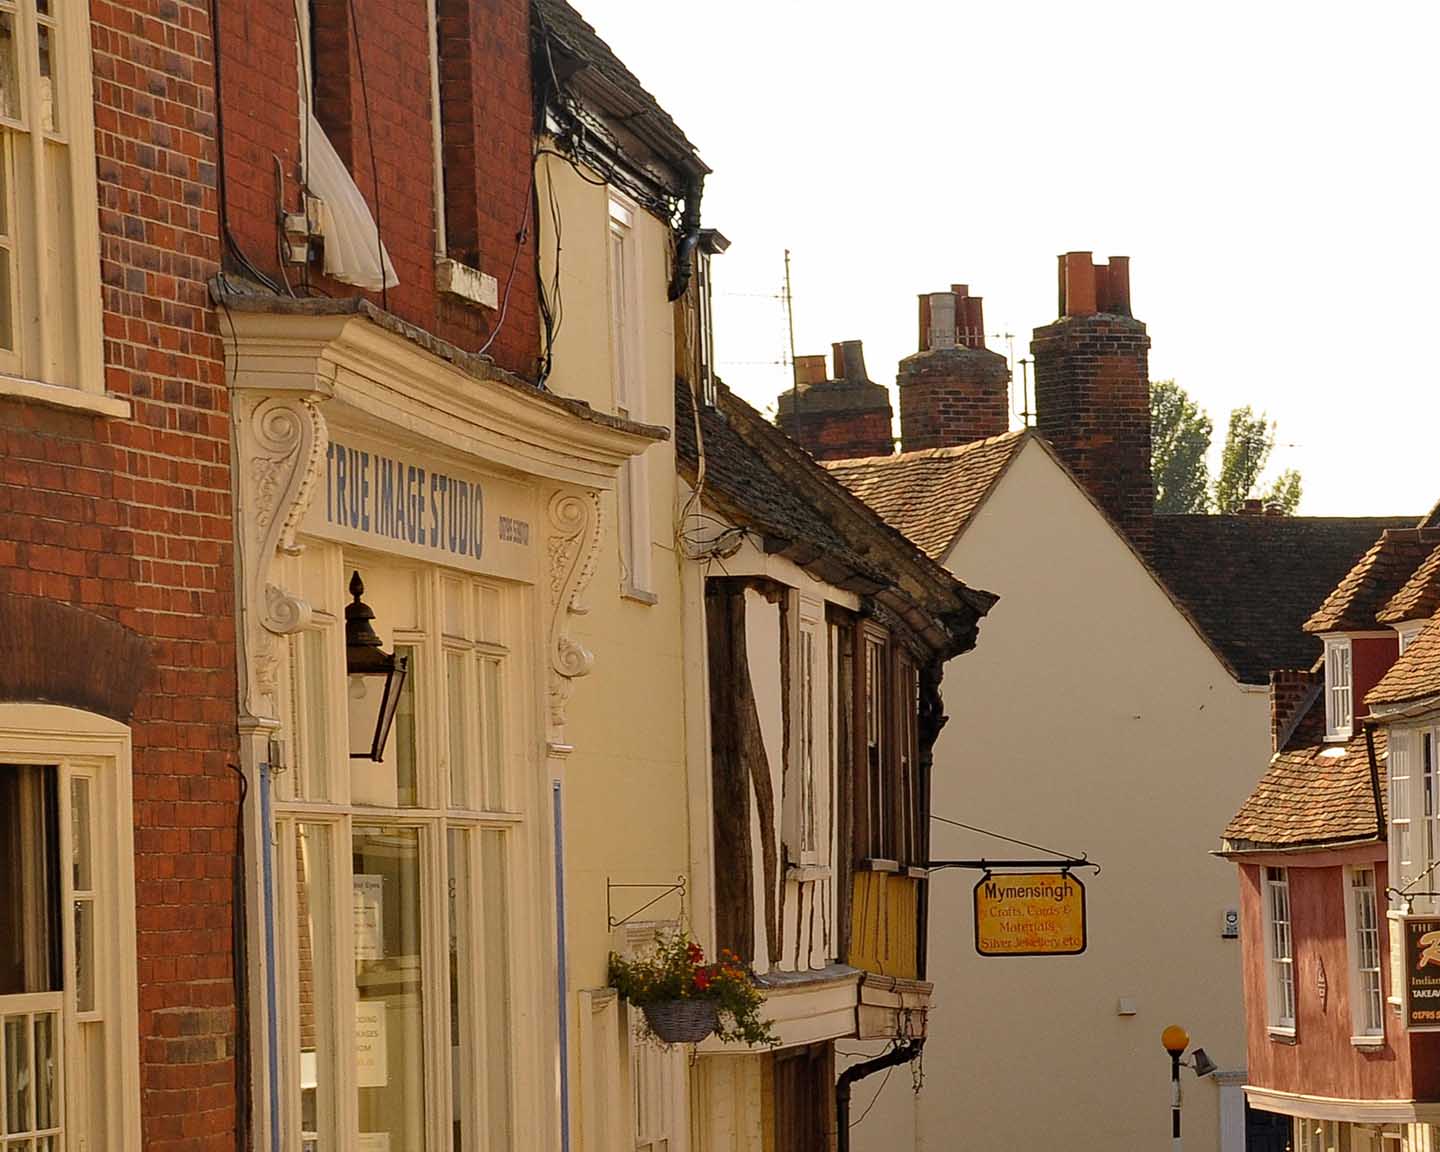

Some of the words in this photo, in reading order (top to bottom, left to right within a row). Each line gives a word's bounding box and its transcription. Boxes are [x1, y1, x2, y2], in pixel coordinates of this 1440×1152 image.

[327, 441, 370, 532] TRUE
[375, 455, 425, 545] IMAGE
[430, 473, 483, 560] STUDIO
[985, 881, 1073, 902] Mymensingh
[1410, 923, 1432, 932] THE
[982, 937, 1012, 949] Silver
